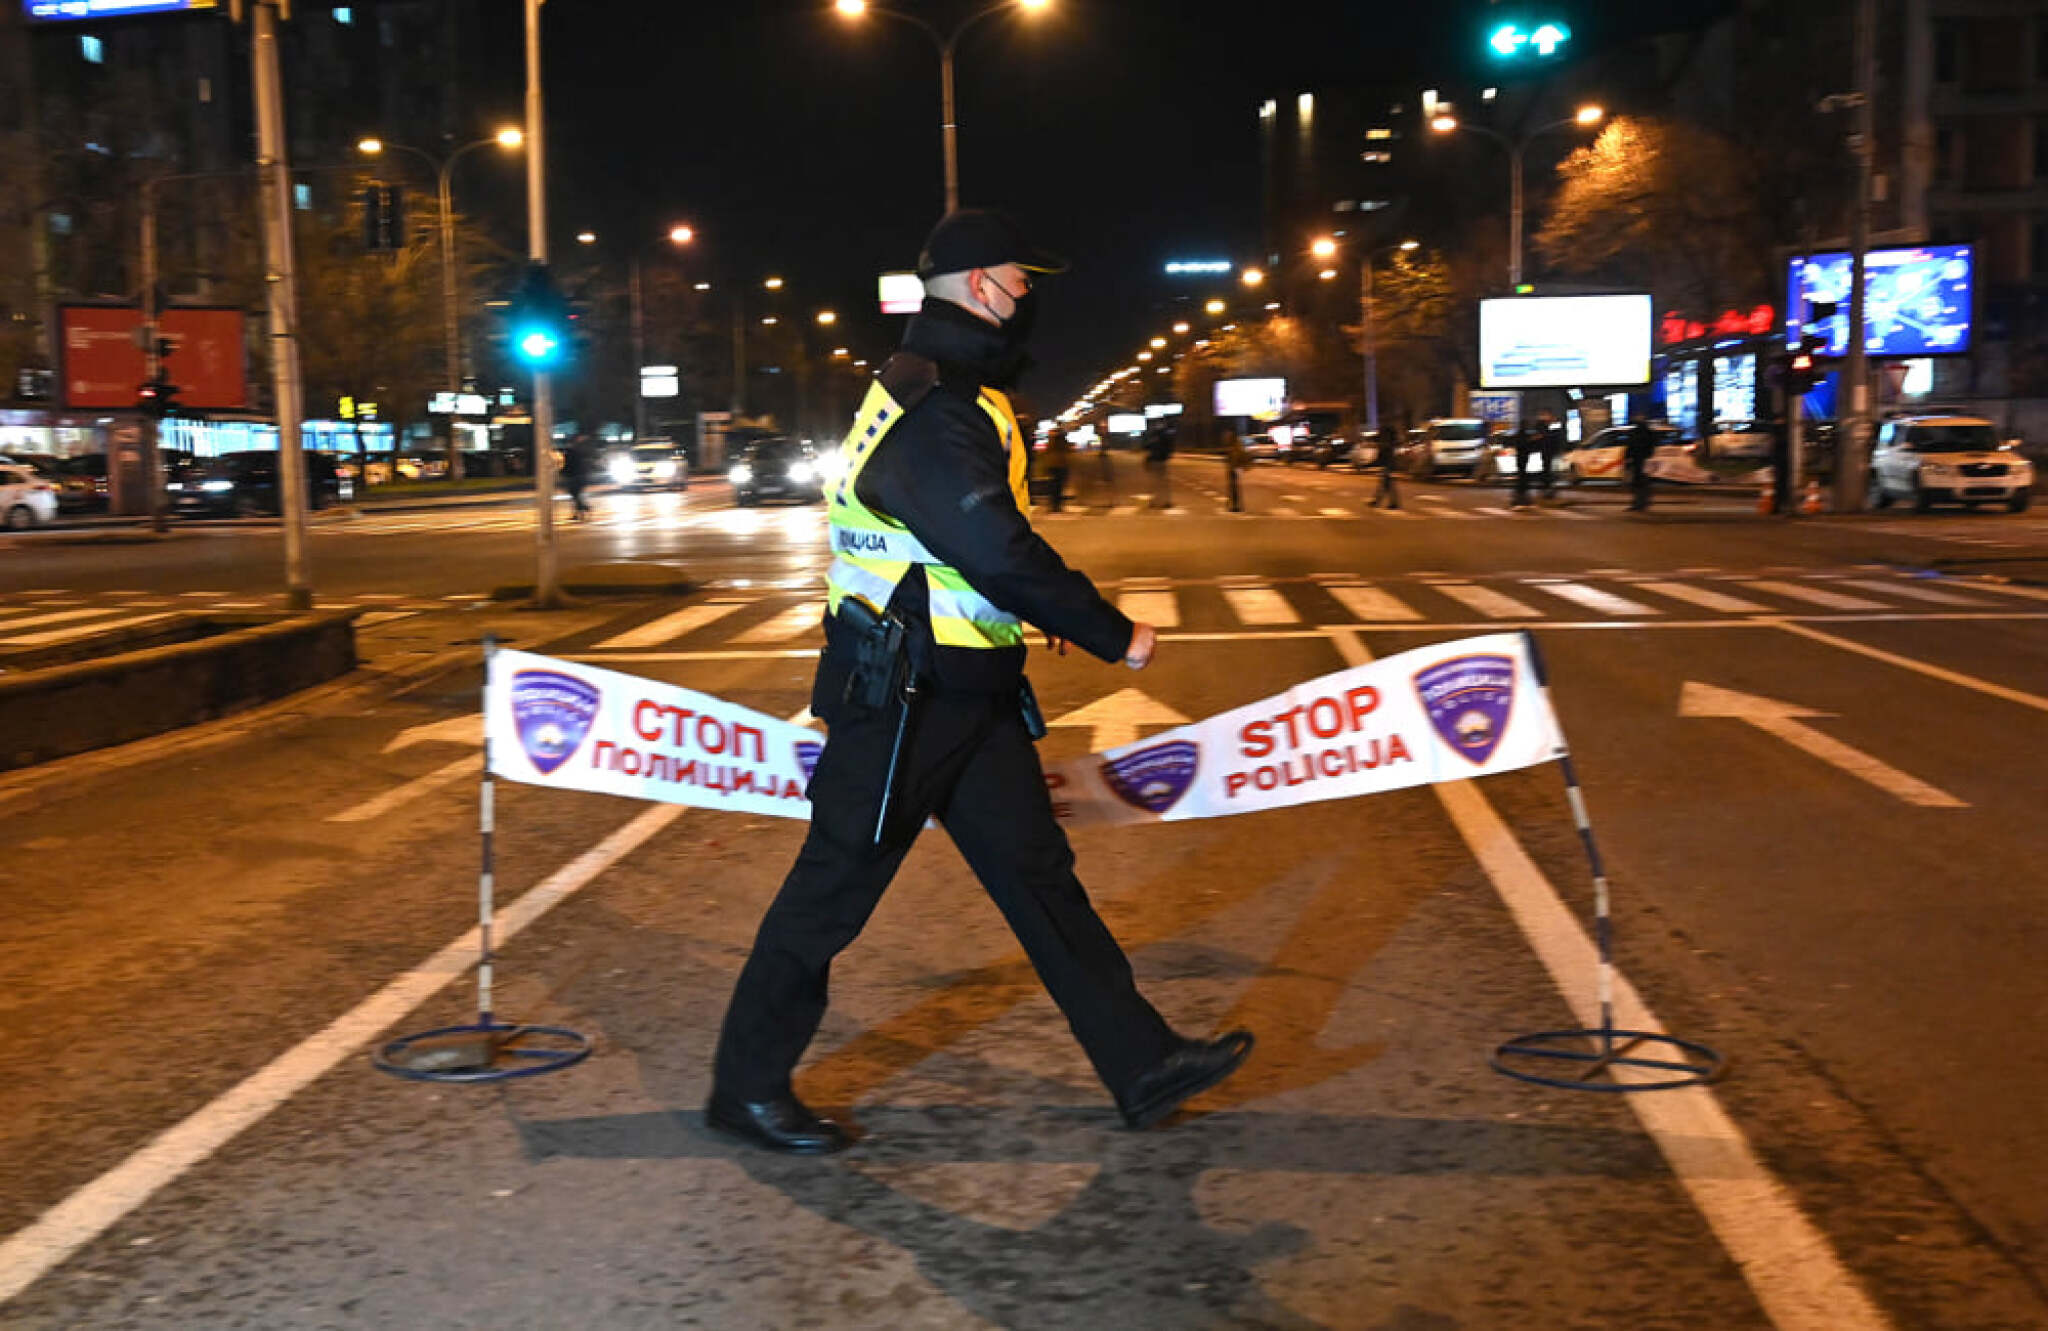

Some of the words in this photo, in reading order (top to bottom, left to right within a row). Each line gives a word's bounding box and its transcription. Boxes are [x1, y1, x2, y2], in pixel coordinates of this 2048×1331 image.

[633, 698, 765, 763] СТОП
[1238, 685, 1382, 758] STOP
[1224, 733, 1414, 799] POLICIJA
